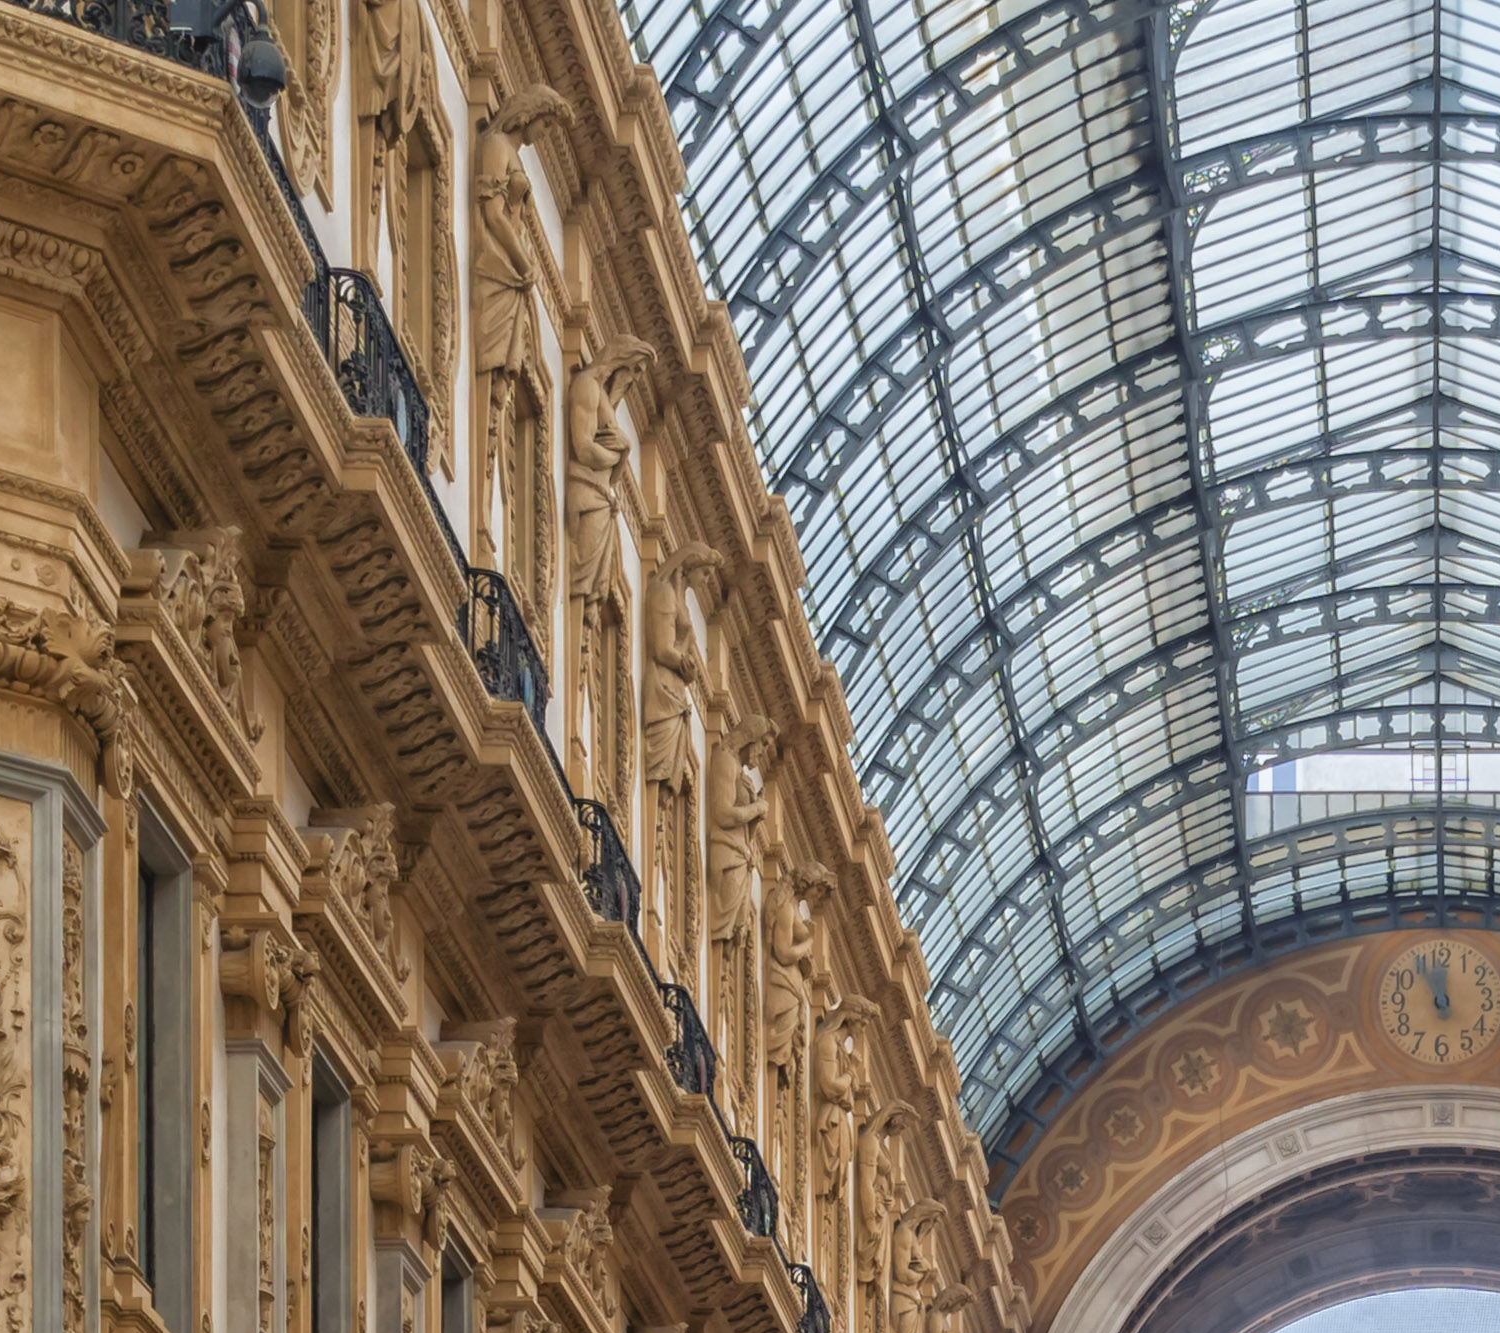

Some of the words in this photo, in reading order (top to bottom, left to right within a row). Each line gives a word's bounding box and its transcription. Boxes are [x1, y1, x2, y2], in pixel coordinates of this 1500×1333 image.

[1430, 947, 1452, 969] 12
[1460, 953, 1467, 973] 1
[1396, 968, 1414, 992] 10
[1473, 965, 1487, 986] 2
[1391, 991, 1406, 1014] 9
[1480, 986, 1494, 1012] 3
[1397, 1012, 1410, 1037] 8
[1472, 1014, 1487, 1037] 4
[1413, 1031, 1426, 1053] 7
[1434, 1034, 1450, 1057] 6
[1460, 1028, 1473, 1051] 5
